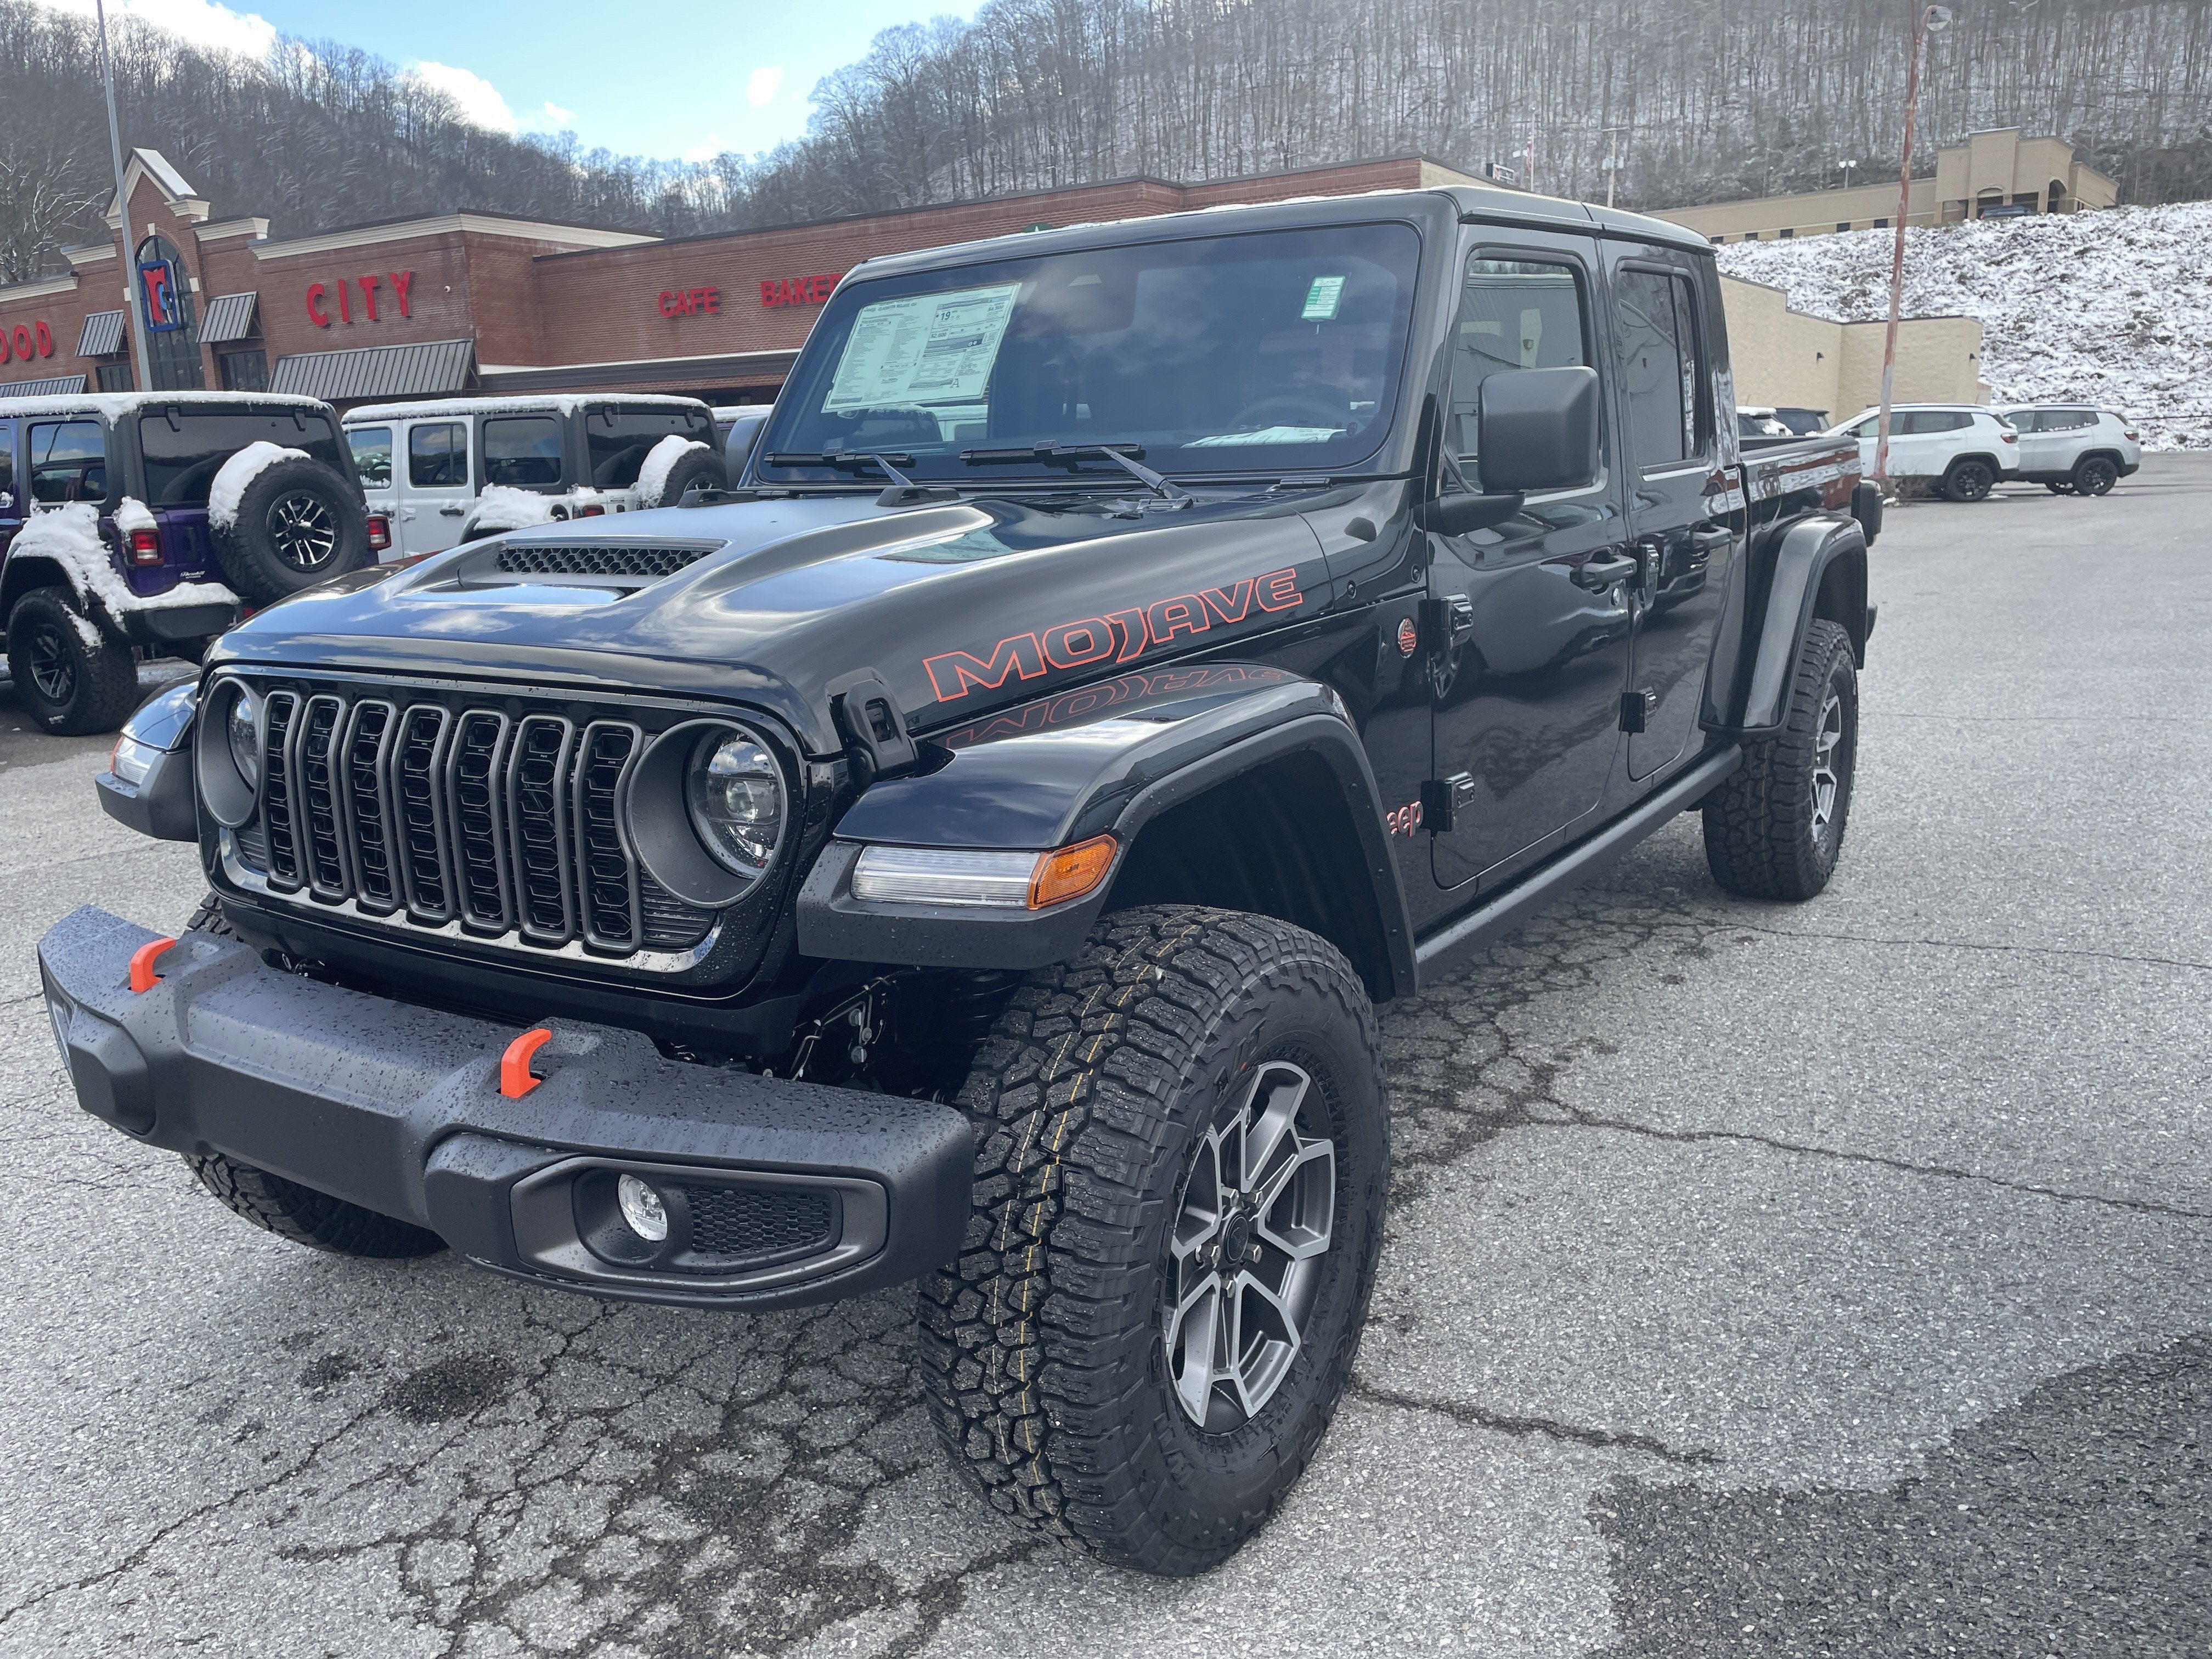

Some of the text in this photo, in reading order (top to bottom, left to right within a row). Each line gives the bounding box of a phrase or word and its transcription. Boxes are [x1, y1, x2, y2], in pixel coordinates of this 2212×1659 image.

[307, 270, 411, 328] CITY
[658, 286, 719, 318] CAFE
[941, 311, 951, 321] 19
[922, 568, 1303, 702] MOJAVE
[1386, 801, 1424, 837] eep
